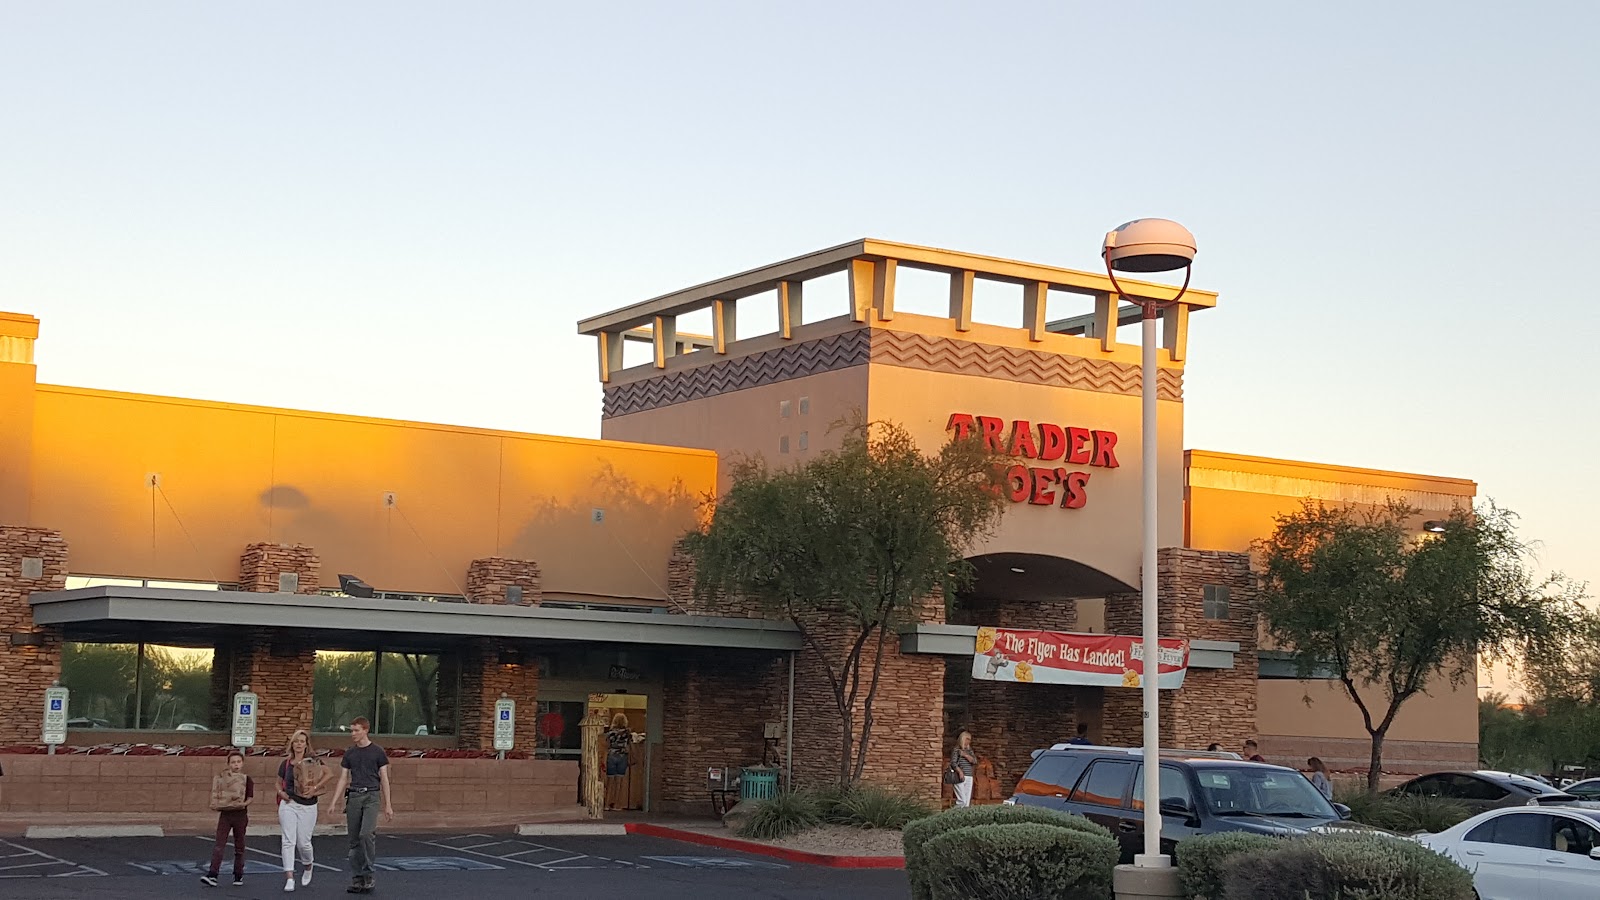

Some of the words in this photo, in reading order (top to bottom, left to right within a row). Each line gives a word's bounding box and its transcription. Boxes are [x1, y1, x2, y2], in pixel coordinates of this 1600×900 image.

[945, 412, 1120, 468] TRADER
[979, 463, 1092, 509] OE'S
[1005, 632, 1025, 653] The
[1028, 637, 1057, 663] Flyer
[1060, 643, 1080, 662] Has
[1083, 648, 1125, 668] Landed!
